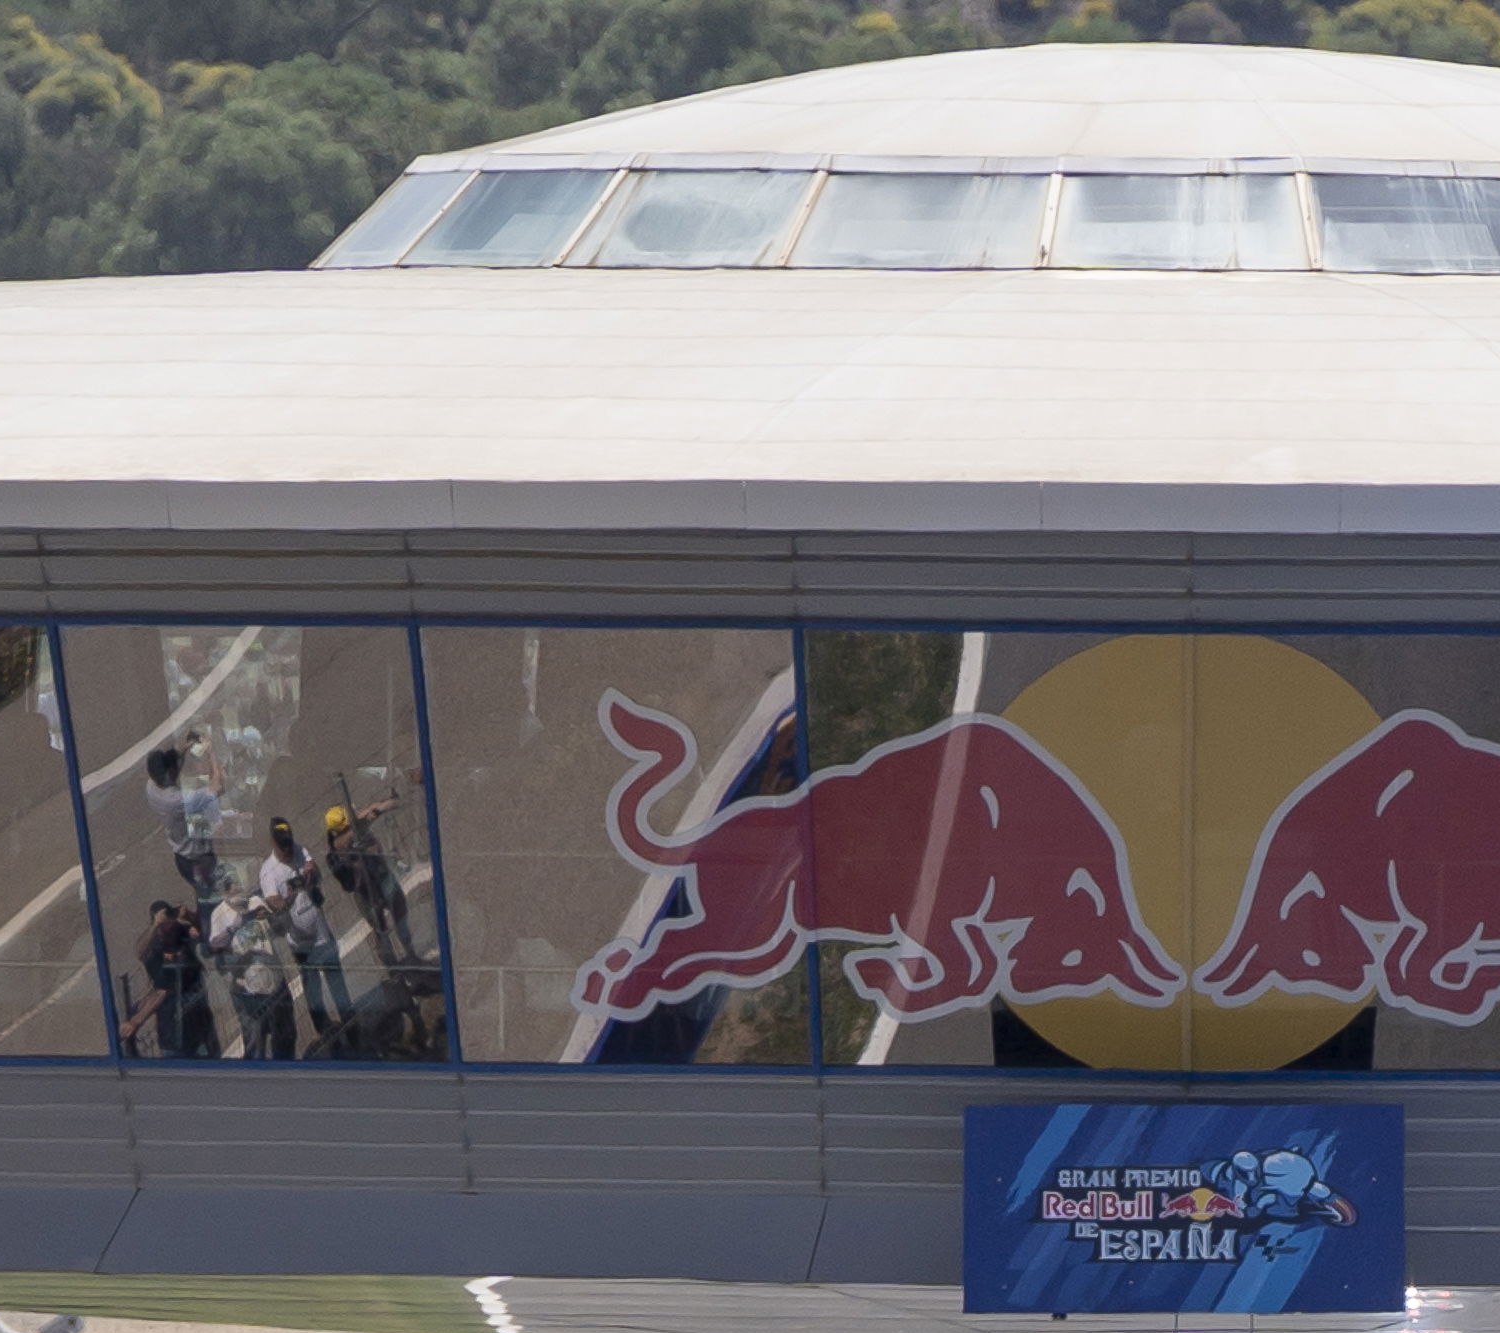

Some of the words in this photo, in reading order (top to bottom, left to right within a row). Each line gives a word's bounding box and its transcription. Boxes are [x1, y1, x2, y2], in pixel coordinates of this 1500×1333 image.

[1058, 1169, 1116, 1188] GRAN
[1124, 1169, 1201, 1188] PREMIO
[1043, 1191, 1097, 1219] Red
[1099, 1191, 1154, 1220] Bull
[1075, 1222, 1099, 1238] DE
[1099, 1222, 1237, 1261] ESPAÑA
